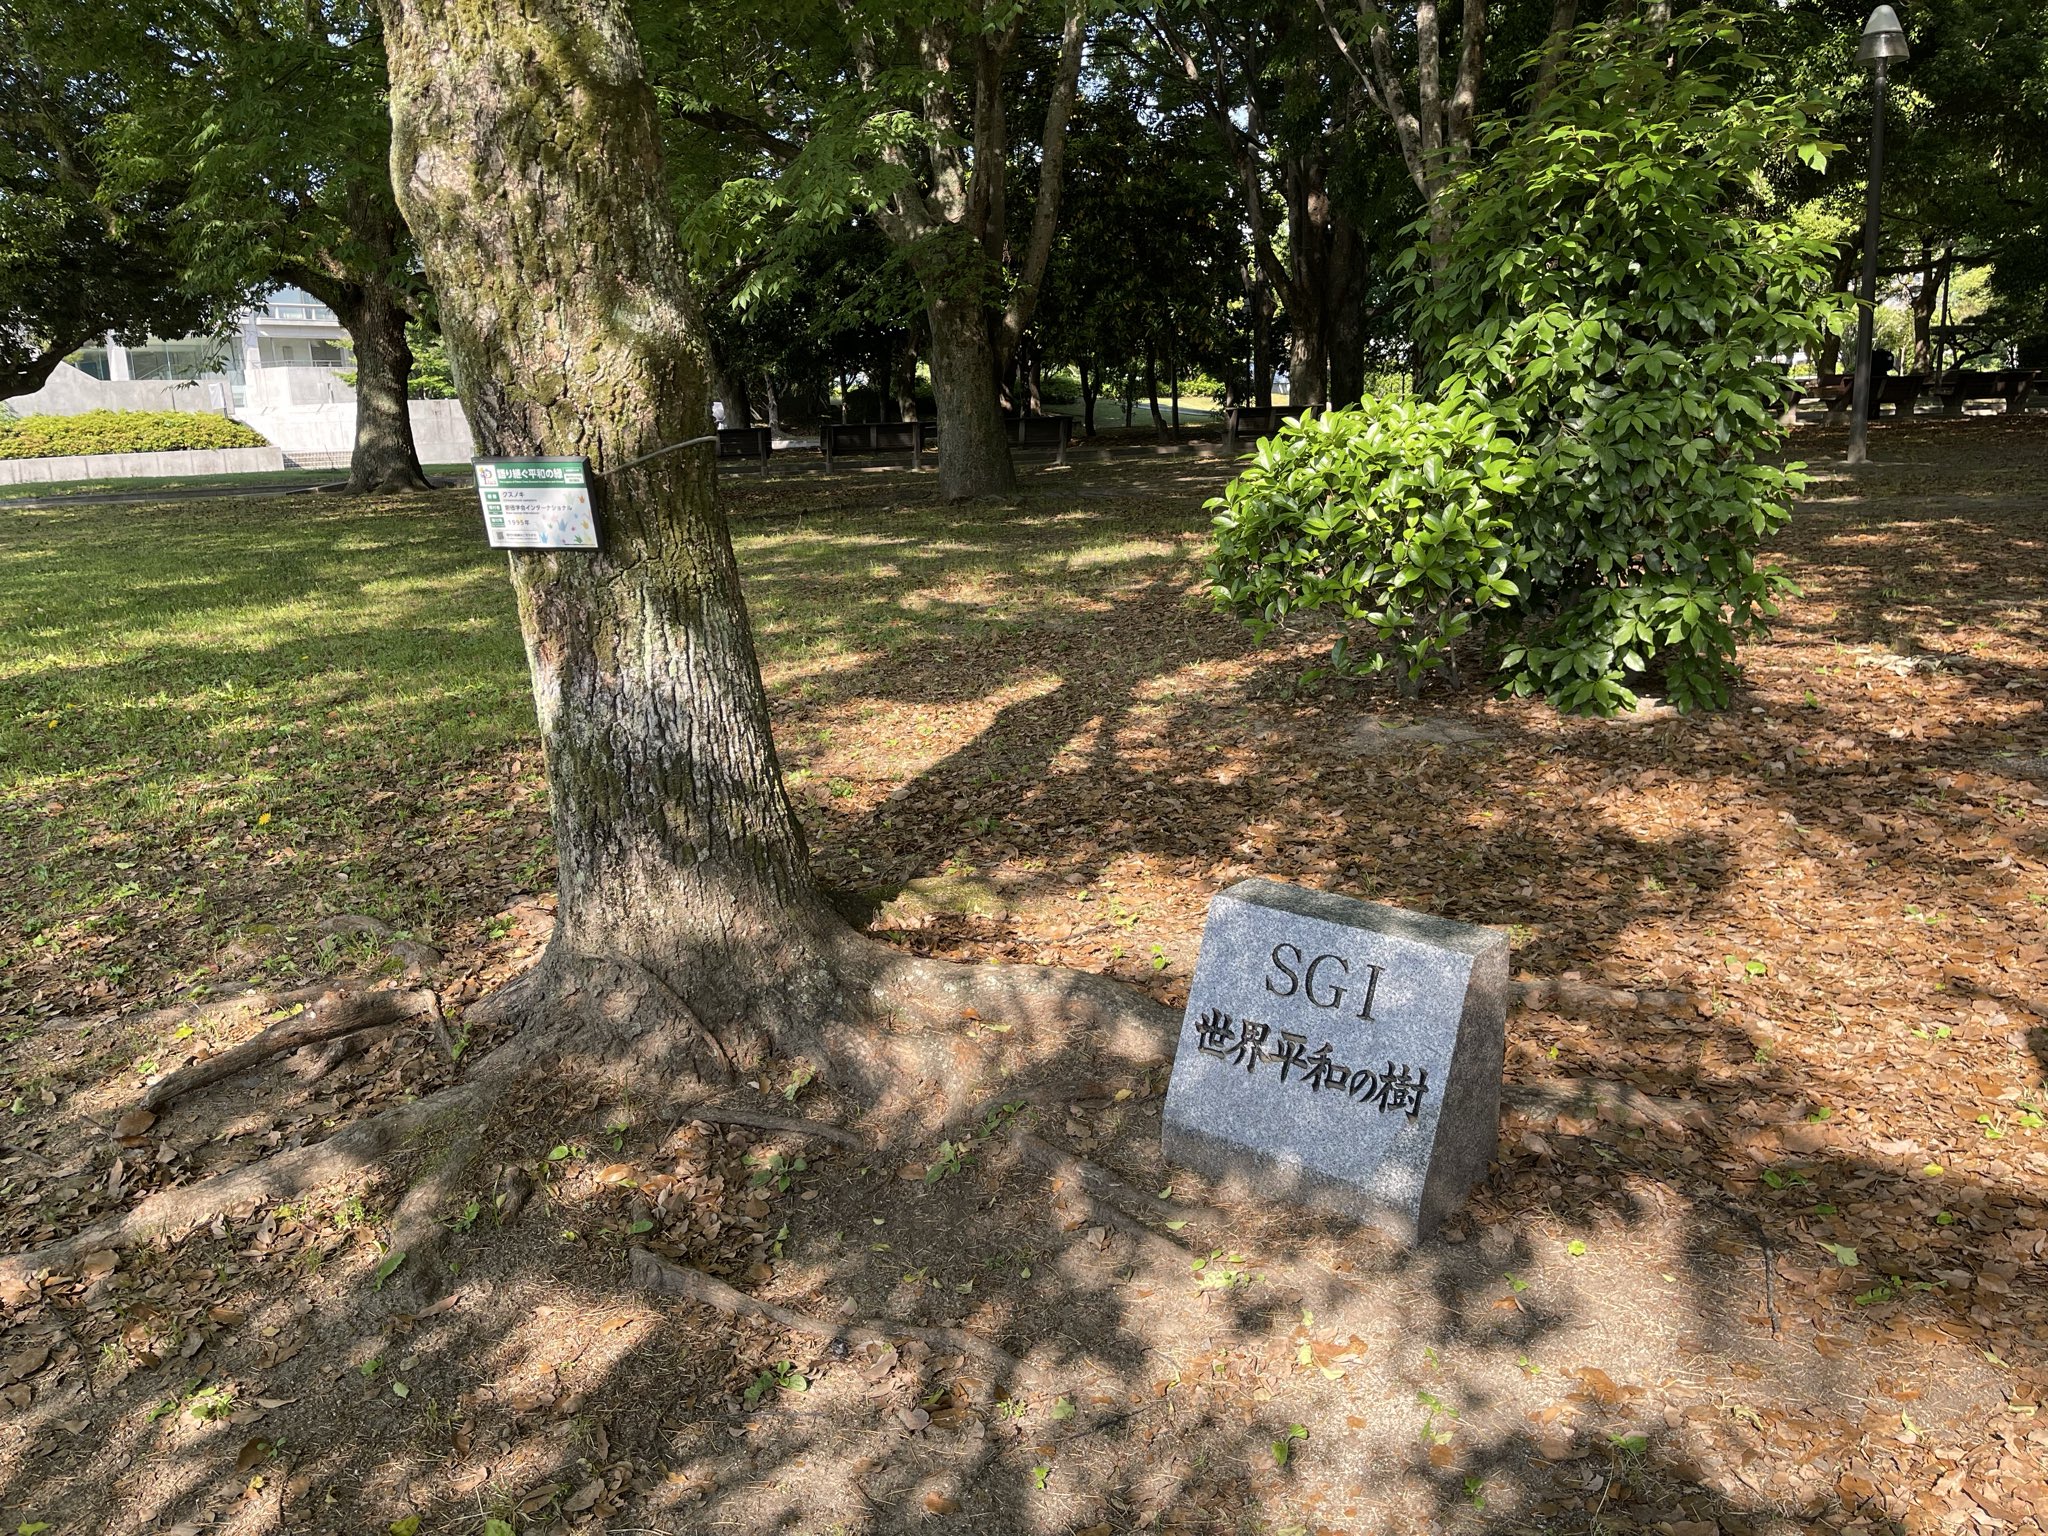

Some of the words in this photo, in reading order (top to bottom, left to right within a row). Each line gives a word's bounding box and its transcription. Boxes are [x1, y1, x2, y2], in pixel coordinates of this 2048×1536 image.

[1265, 942, 1386, 1023] SGI
[1195, 1007, 1430, 1125] 世界平和の樹
